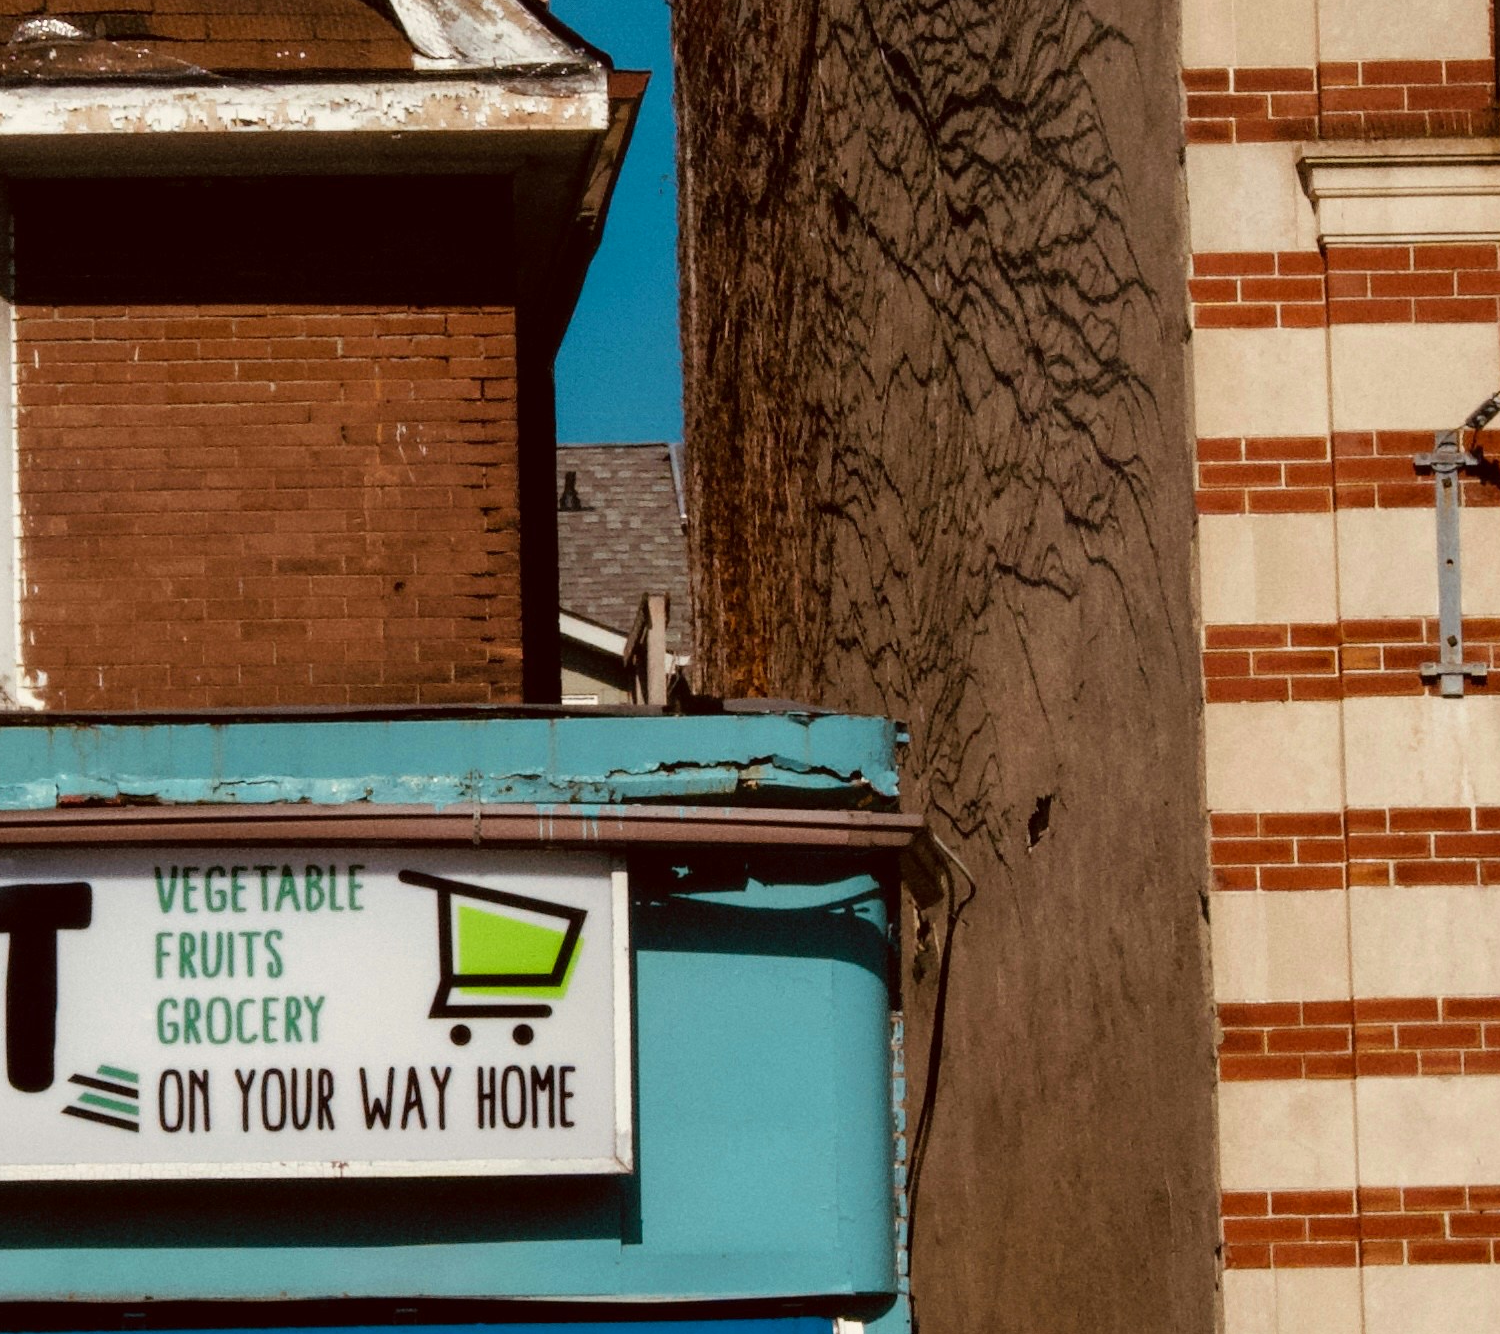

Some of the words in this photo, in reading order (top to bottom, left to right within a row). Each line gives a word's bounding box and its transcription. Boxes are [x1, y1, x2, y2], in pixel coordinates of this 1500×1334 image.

[153, 864, 366, 914] VEGETABLE
[154, 929, 284, 980] FRUITS
[156, 995, 326, 1045] GROCERY
[158, 1068, 211, 1133] ON
[234, 1068, 336, 1132] YOUR
[359, 1066, 453, 1131] WAY
[476, 1065, 577, 1130] HOME
